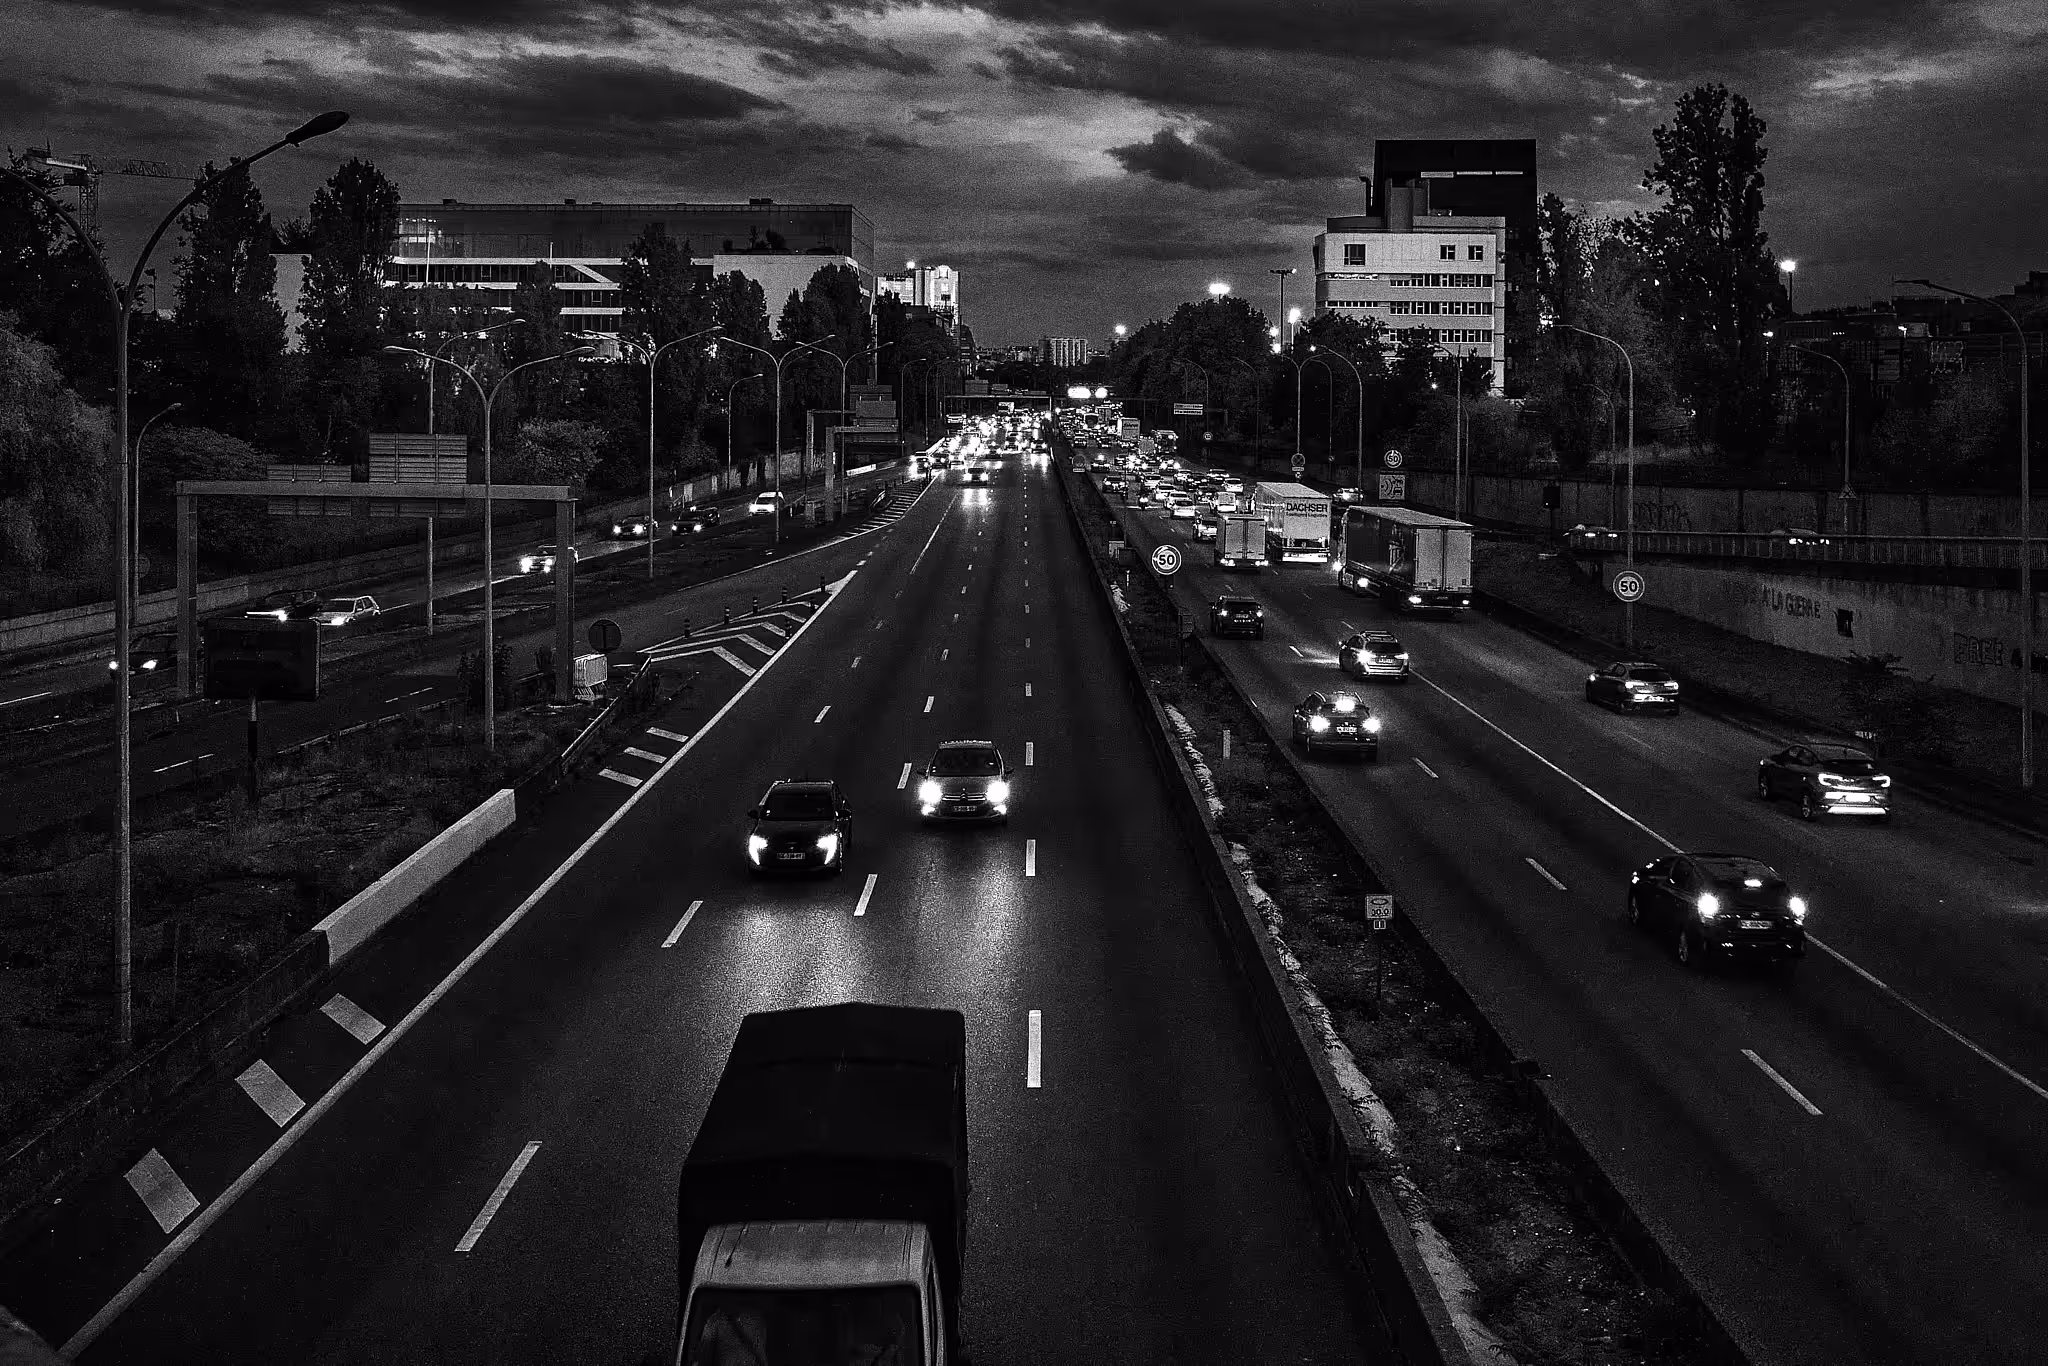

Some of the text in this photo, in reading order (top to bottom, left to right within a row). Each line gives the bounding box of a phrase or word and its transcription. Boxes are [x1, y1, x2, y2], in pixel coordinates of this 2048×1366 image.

[1389, 455, 1398, 463] 50
[1286, 502, 1328, 513] DACHSER
[1159, 554, 1175, 566] 50
[1620, 580, 1638, 593] 50
